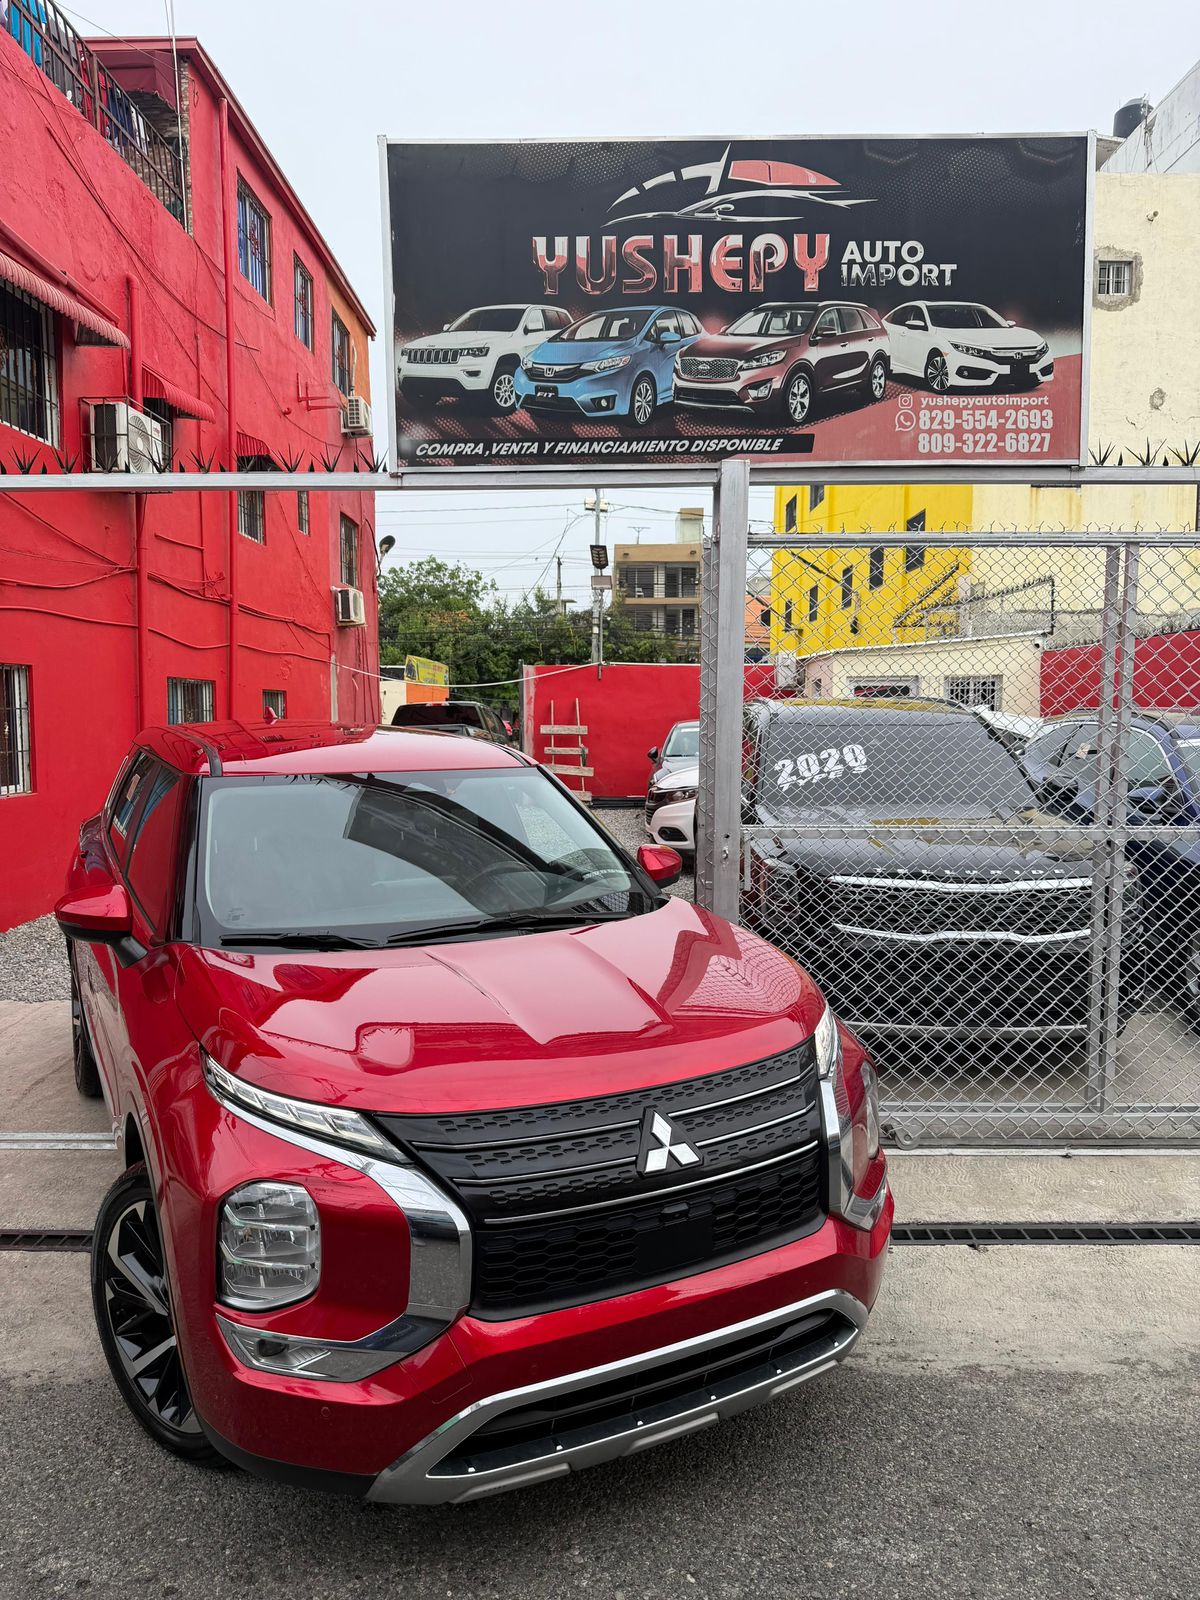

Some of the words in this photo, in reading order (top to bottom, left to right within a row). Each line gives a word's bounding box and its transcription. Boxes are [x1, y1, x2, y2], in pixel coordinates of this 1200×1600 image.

[841, 240, 924, 263] AUTO
[532, 233, 830, 295] YUSHEPY
[841, 264, 957, 287] IMPORT
[921, 395, 1049, 408] yushepyautoimport
[919, 409, 1054, 430] 829-554-2693
[543, 441, 555, 454] Y
[554, 440, 690, 455] FINANCIAMIENTO
[690, 438, 783, 452] DISPONIBLE
[918, 432, 1051, 453] 809-322-6827
[774, 744, 867, 785] 2020
